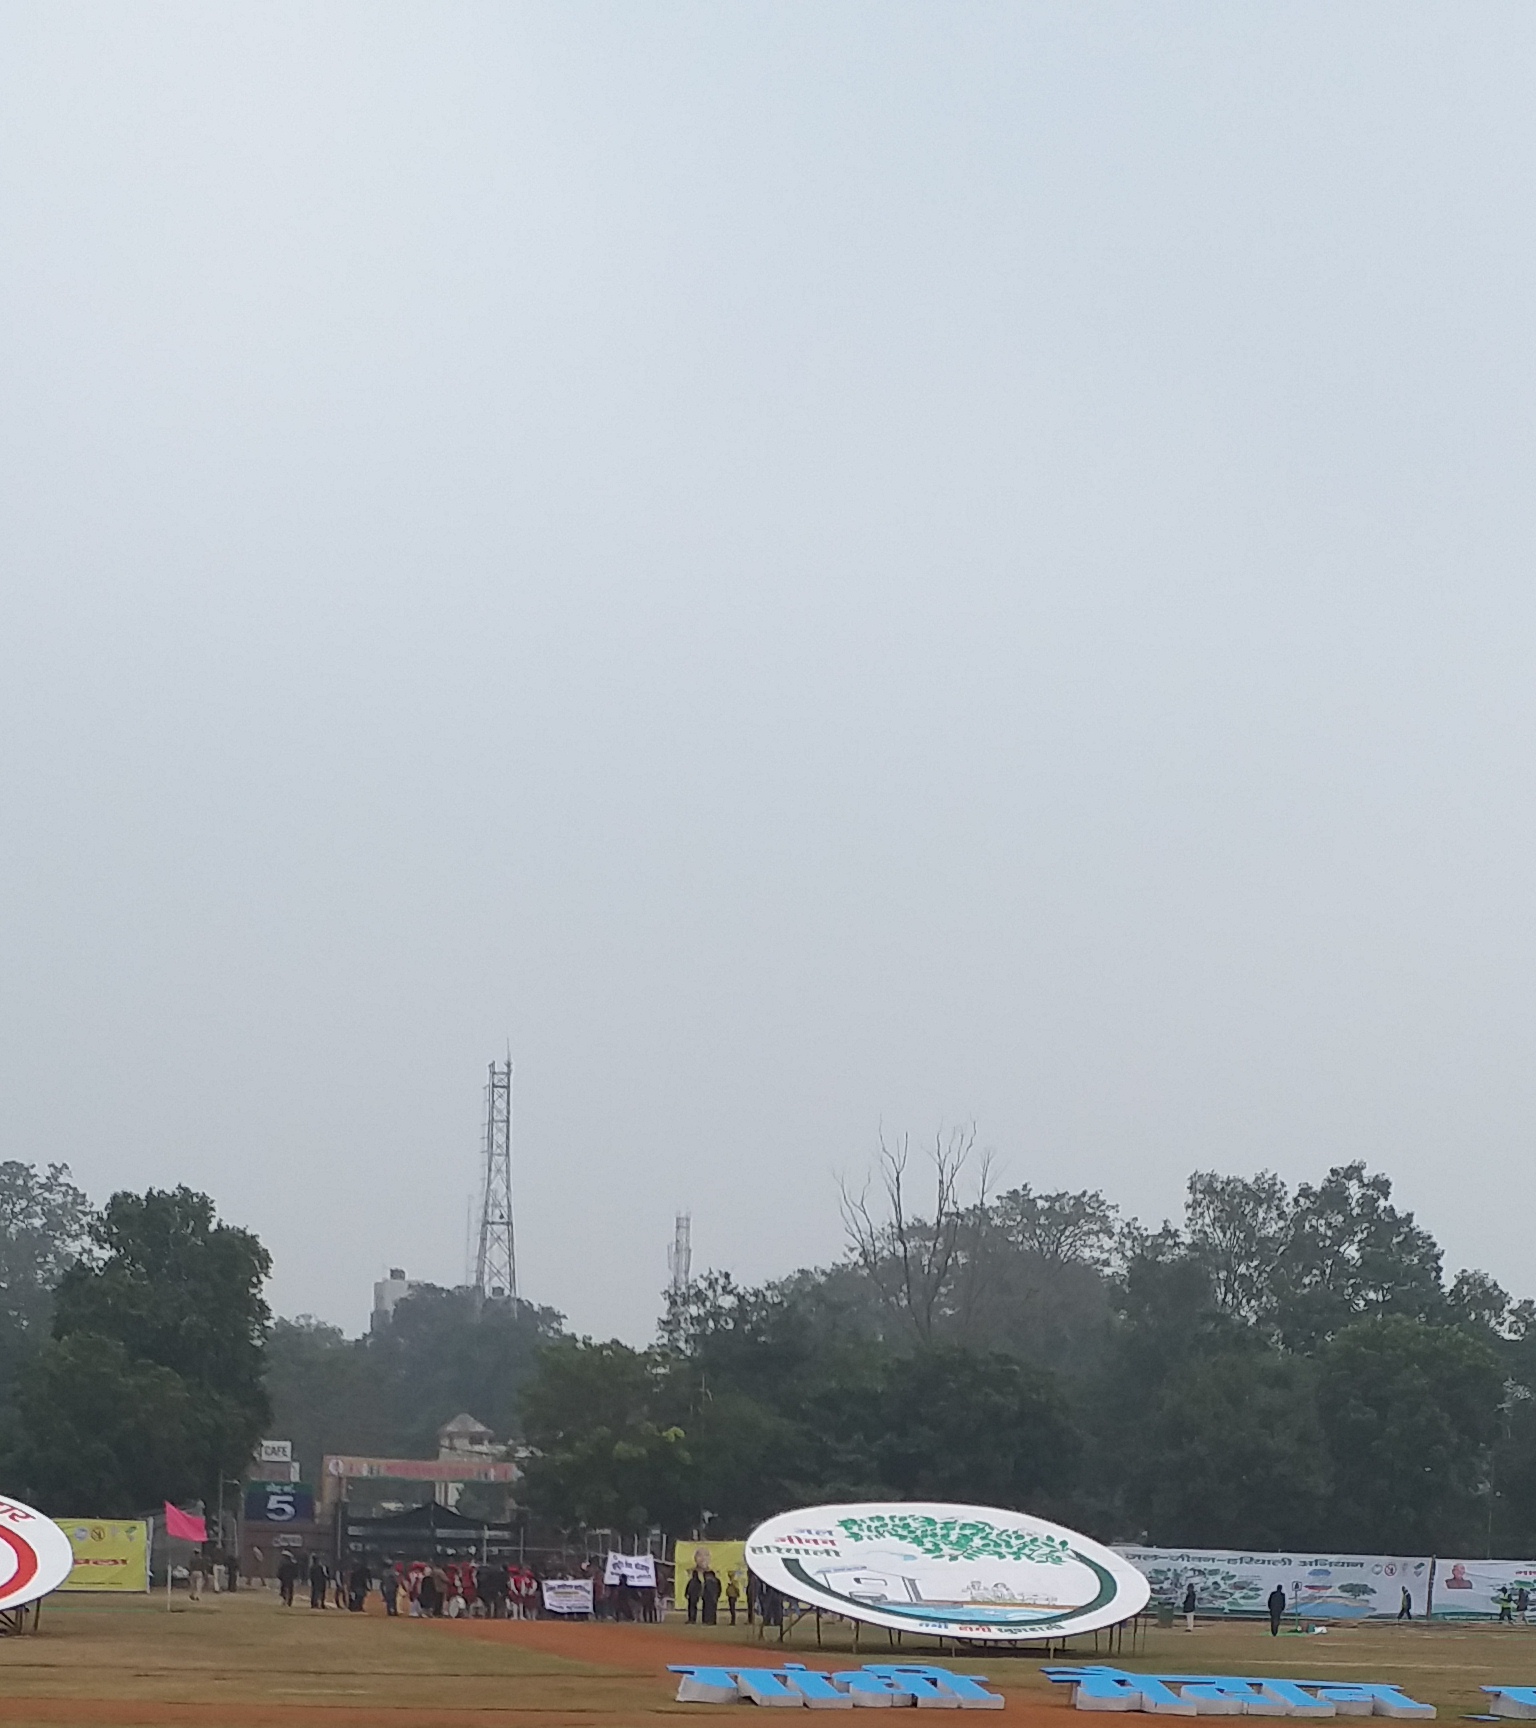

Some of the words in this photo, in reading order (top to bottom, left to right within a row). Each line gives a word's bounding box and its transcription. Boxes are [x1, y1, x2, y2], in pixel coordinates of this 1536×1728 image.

[265, 1446, 288, 1456] CAFE
[266, 1495, 295, 1521] 5
[750, 1545, 841, 1557] हरियाली
[667, 1663, 1005, 1709] गांधी
[1040, 1665, 1436, 1719] मैदान
